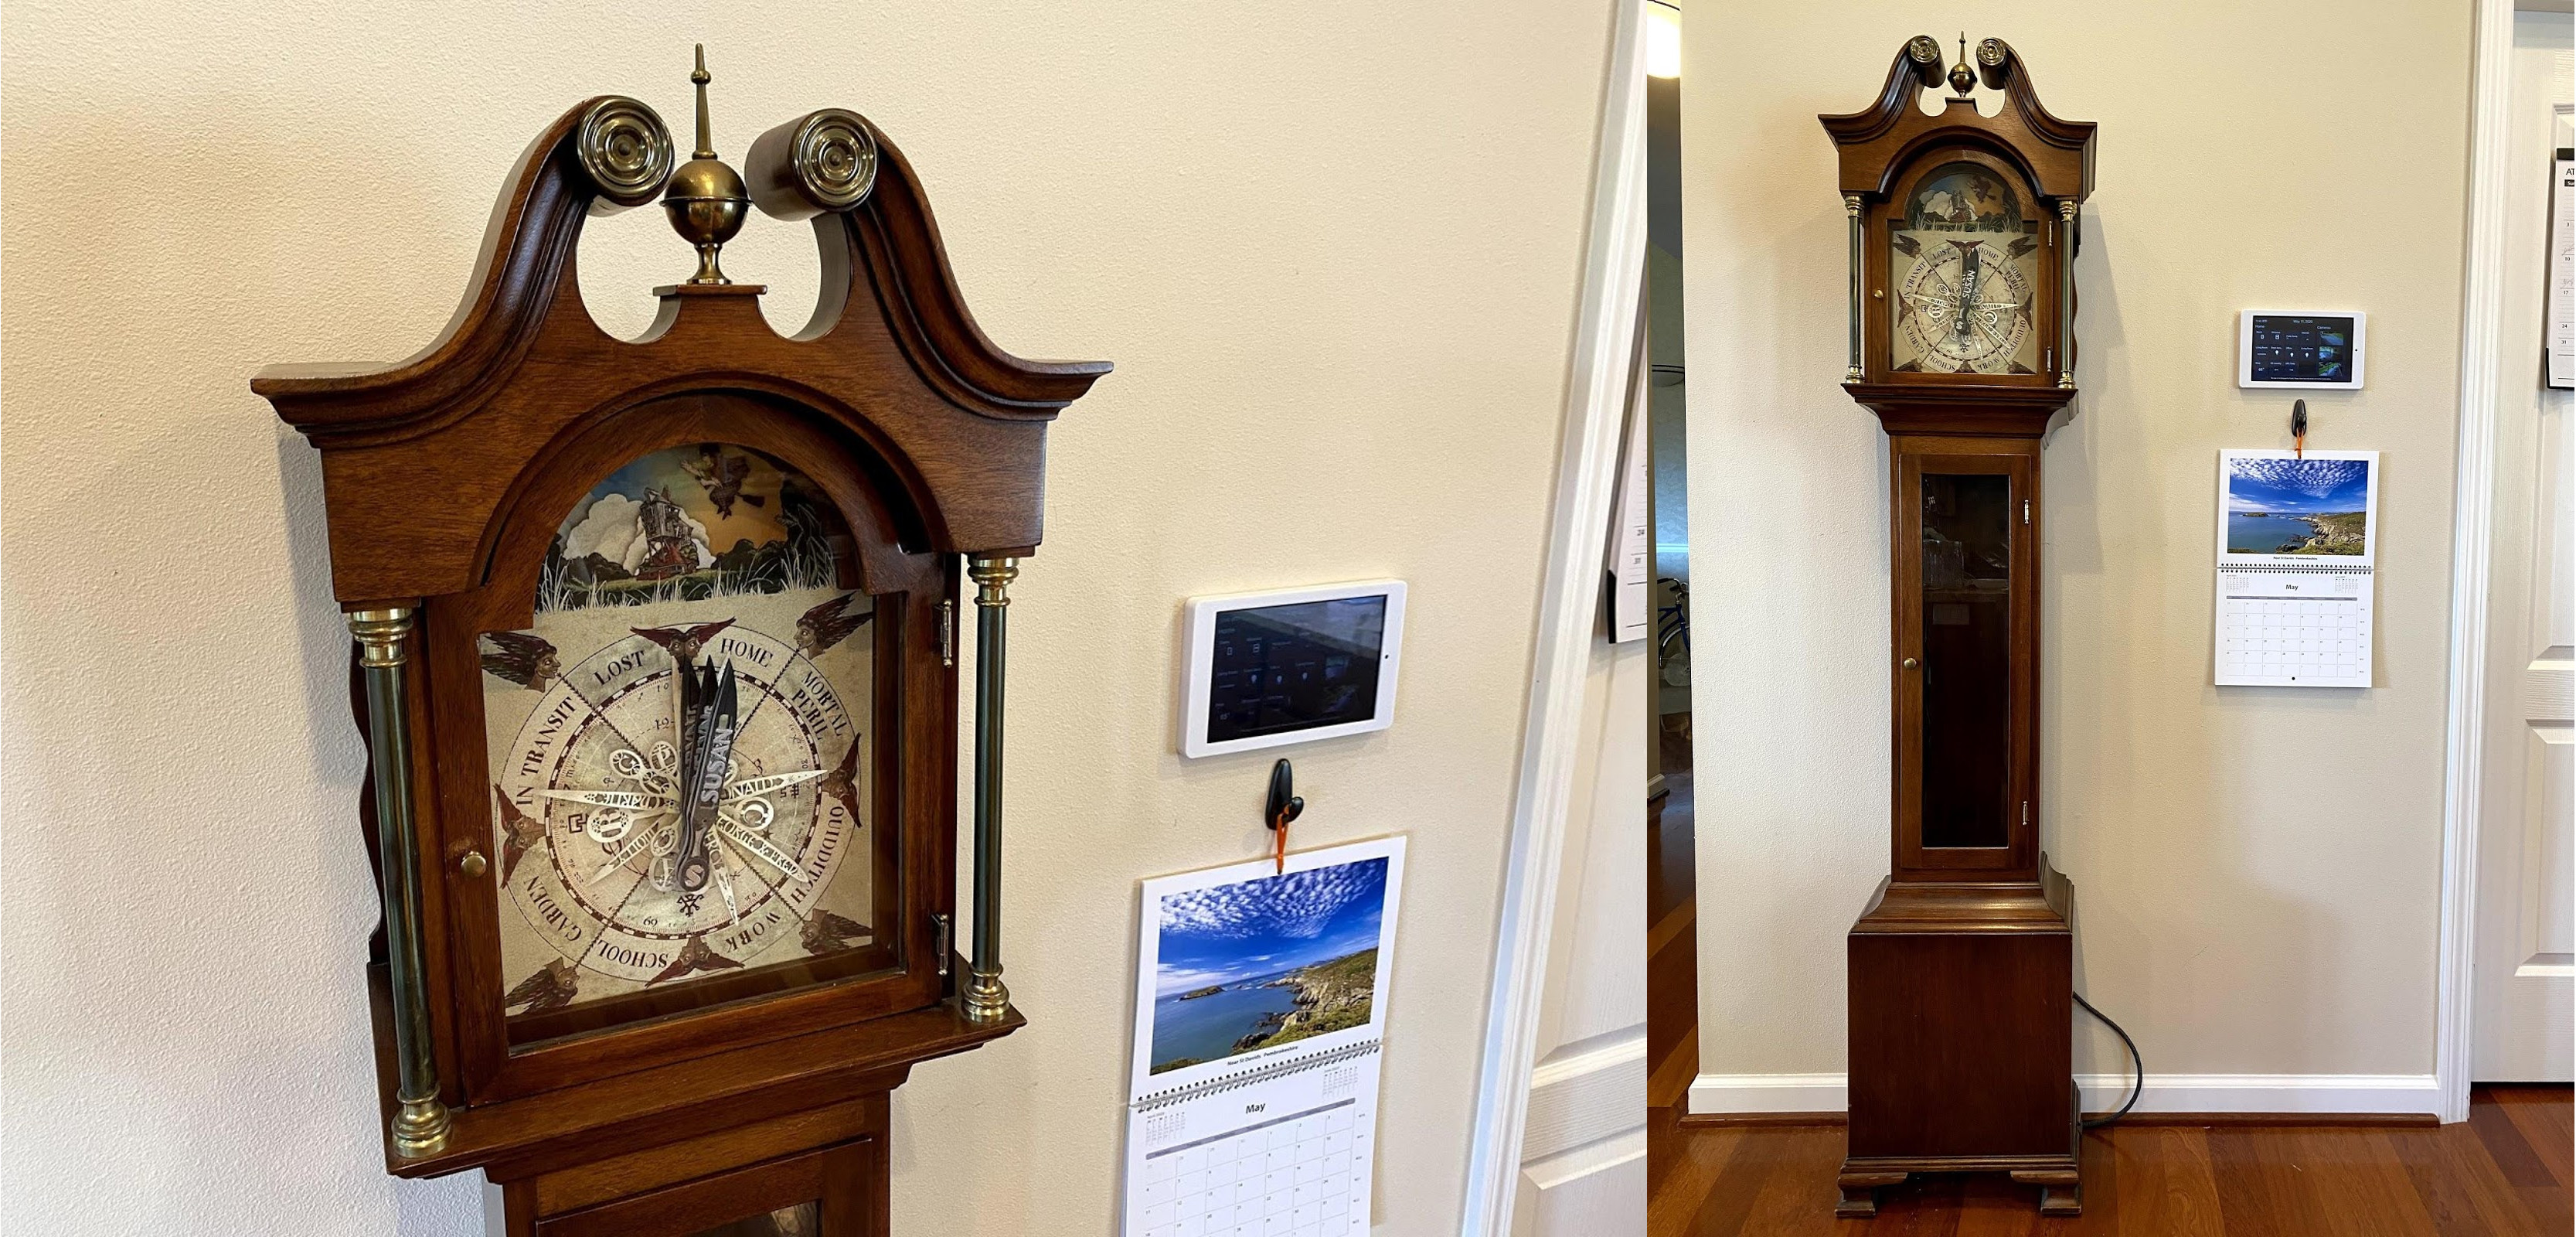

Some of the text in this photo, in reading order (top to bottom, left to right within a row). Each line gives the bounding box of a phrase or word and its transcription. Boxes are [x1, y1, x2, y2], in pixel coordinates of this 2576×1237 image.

[1932, 247, 1952, 260] LOST
[1979, 247, 1999, 261] HOME
[1906, 261, 1926, 290] TRANSIT
[1962, 269, 1976, 299] SUSAN
[2005, 271, 2018, 293] PERIL
[2009, 264, 2027, 292] MORTAL
[1905, 325, 1925, 354] GARDEN
[2003, 319, 2027, 357] QUIDDITCH
[1929, 354, 1956, 372] SCHOOL
[1977, 357, 2000, 371] WORK
[593, 649, 645, 687] LOST
[720, 637, 774, 669] HOME
[790, 688, 832, 742] PERIL
[803, 670, 850, 738] MORTAL
[516, 696, 578, 806] IN TRANSIT
[700, 728, 733, 803] SUSAN
[790, 806, 846, 905] QUIDDITCH
[523, 874, 582, 942] GARDEN
[725, 912, 781, 951] WORK
[597, 939, 669, 969] SCHOOL
[1245, 1102, 1266, 1114] May
